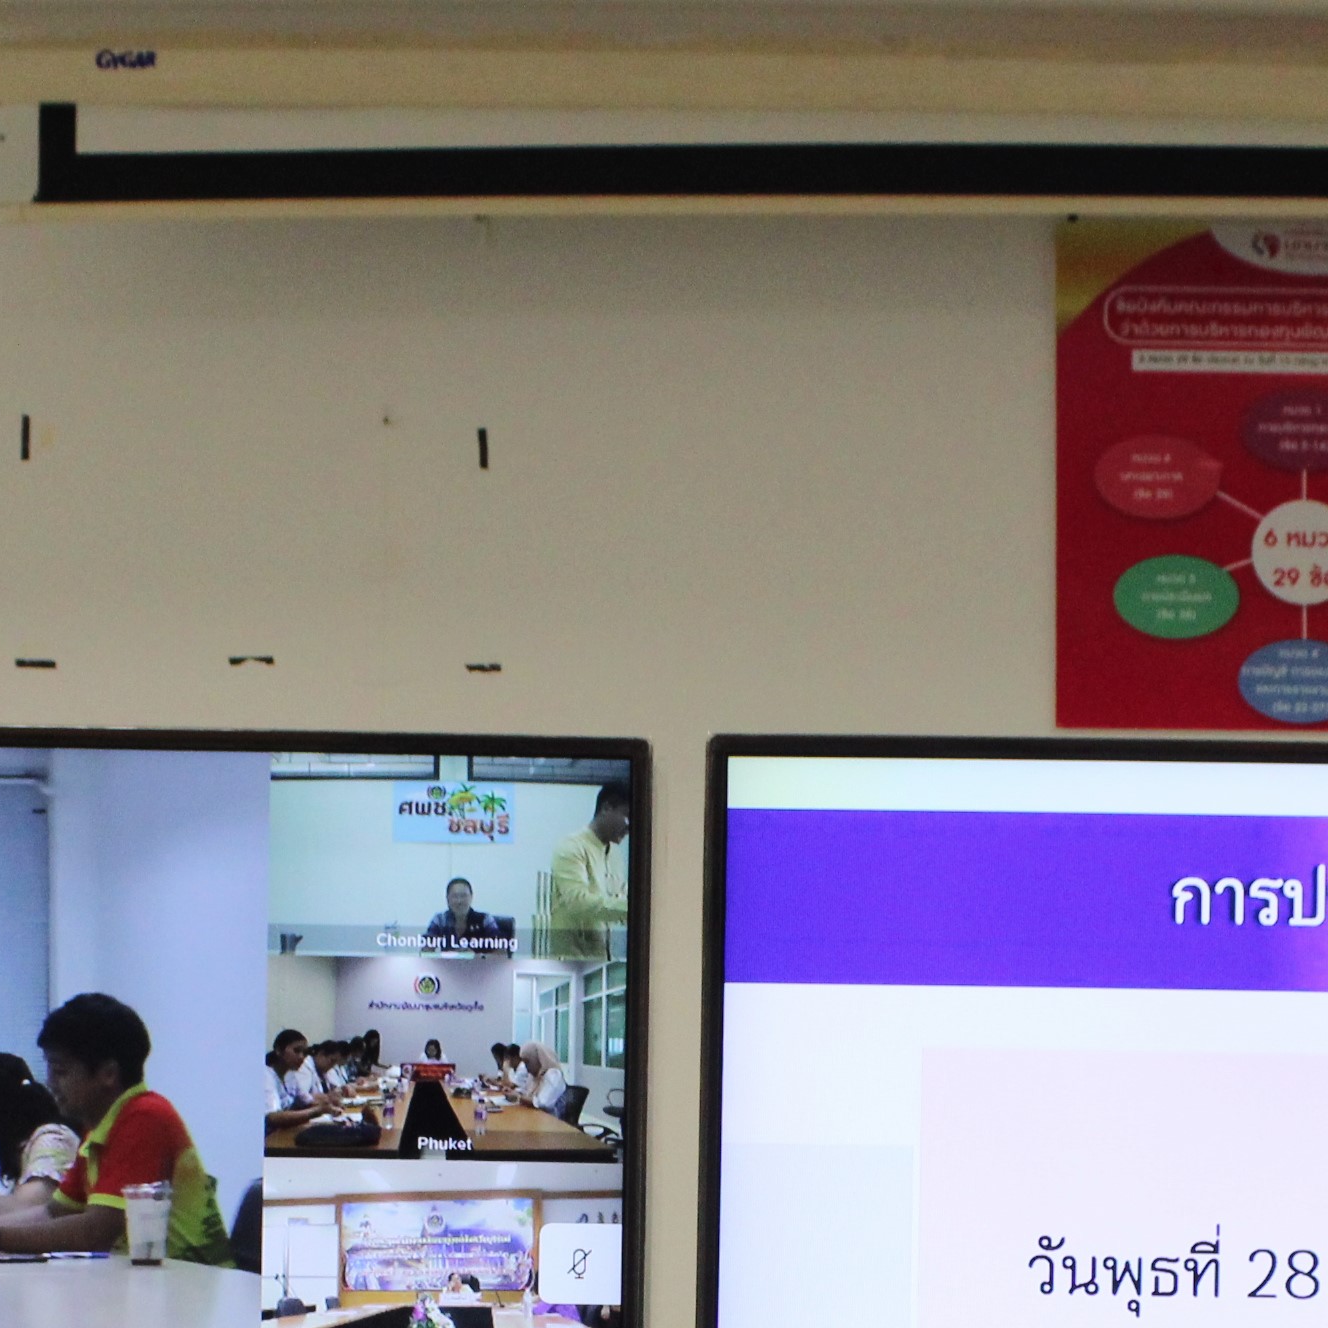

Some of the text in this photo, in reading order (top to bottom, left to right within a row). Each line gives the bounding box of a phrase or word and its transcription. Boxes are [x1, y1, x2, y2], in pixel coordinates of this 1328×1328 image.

[1264, 530, 1277, 548] 6
[1273, 568, 1300, 588] 29
[447, 813, 510, 841] ชลบุรี
[376, 933, 519, 952] Chonburi Learning
[417, 1136, 473, 1151] Phuket
[1028, 1224, 1220, 1317] วันพุธที่
[1248, 1249, 1319, 1299] 28
